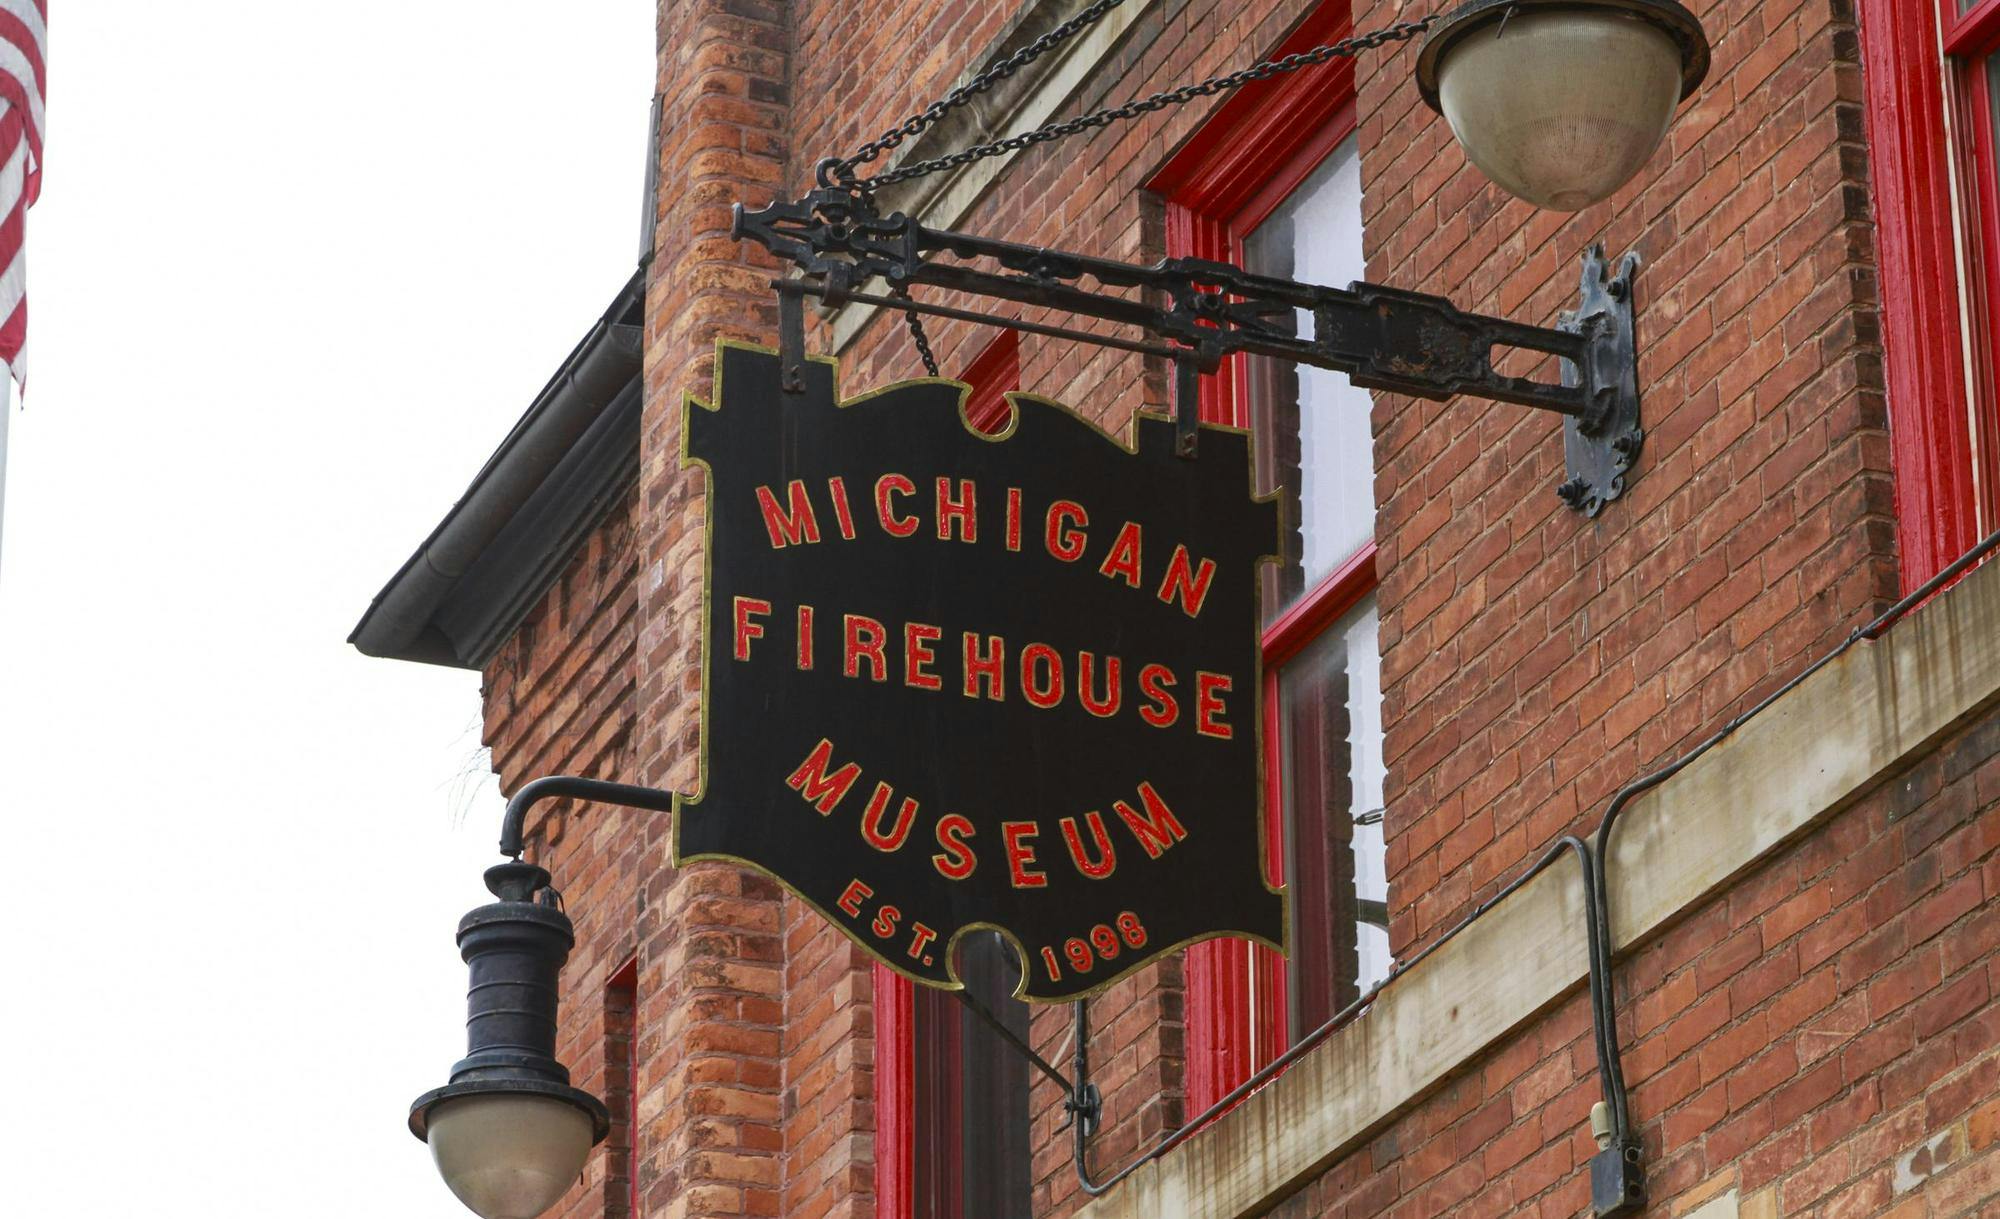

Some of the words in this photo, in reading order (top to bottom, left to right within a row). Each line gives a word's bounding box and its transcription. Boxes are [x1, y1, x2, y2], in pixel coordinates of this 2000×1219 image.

[755, 473, 1217, 618] MICHIGAN
[733, 596, 1233, 740] FIREHOUSE
[785, 738, 1188, 889] MUSEUM
[837, 879, 937, 966] EST.
[1041, 911, 1148, 982] 1998
